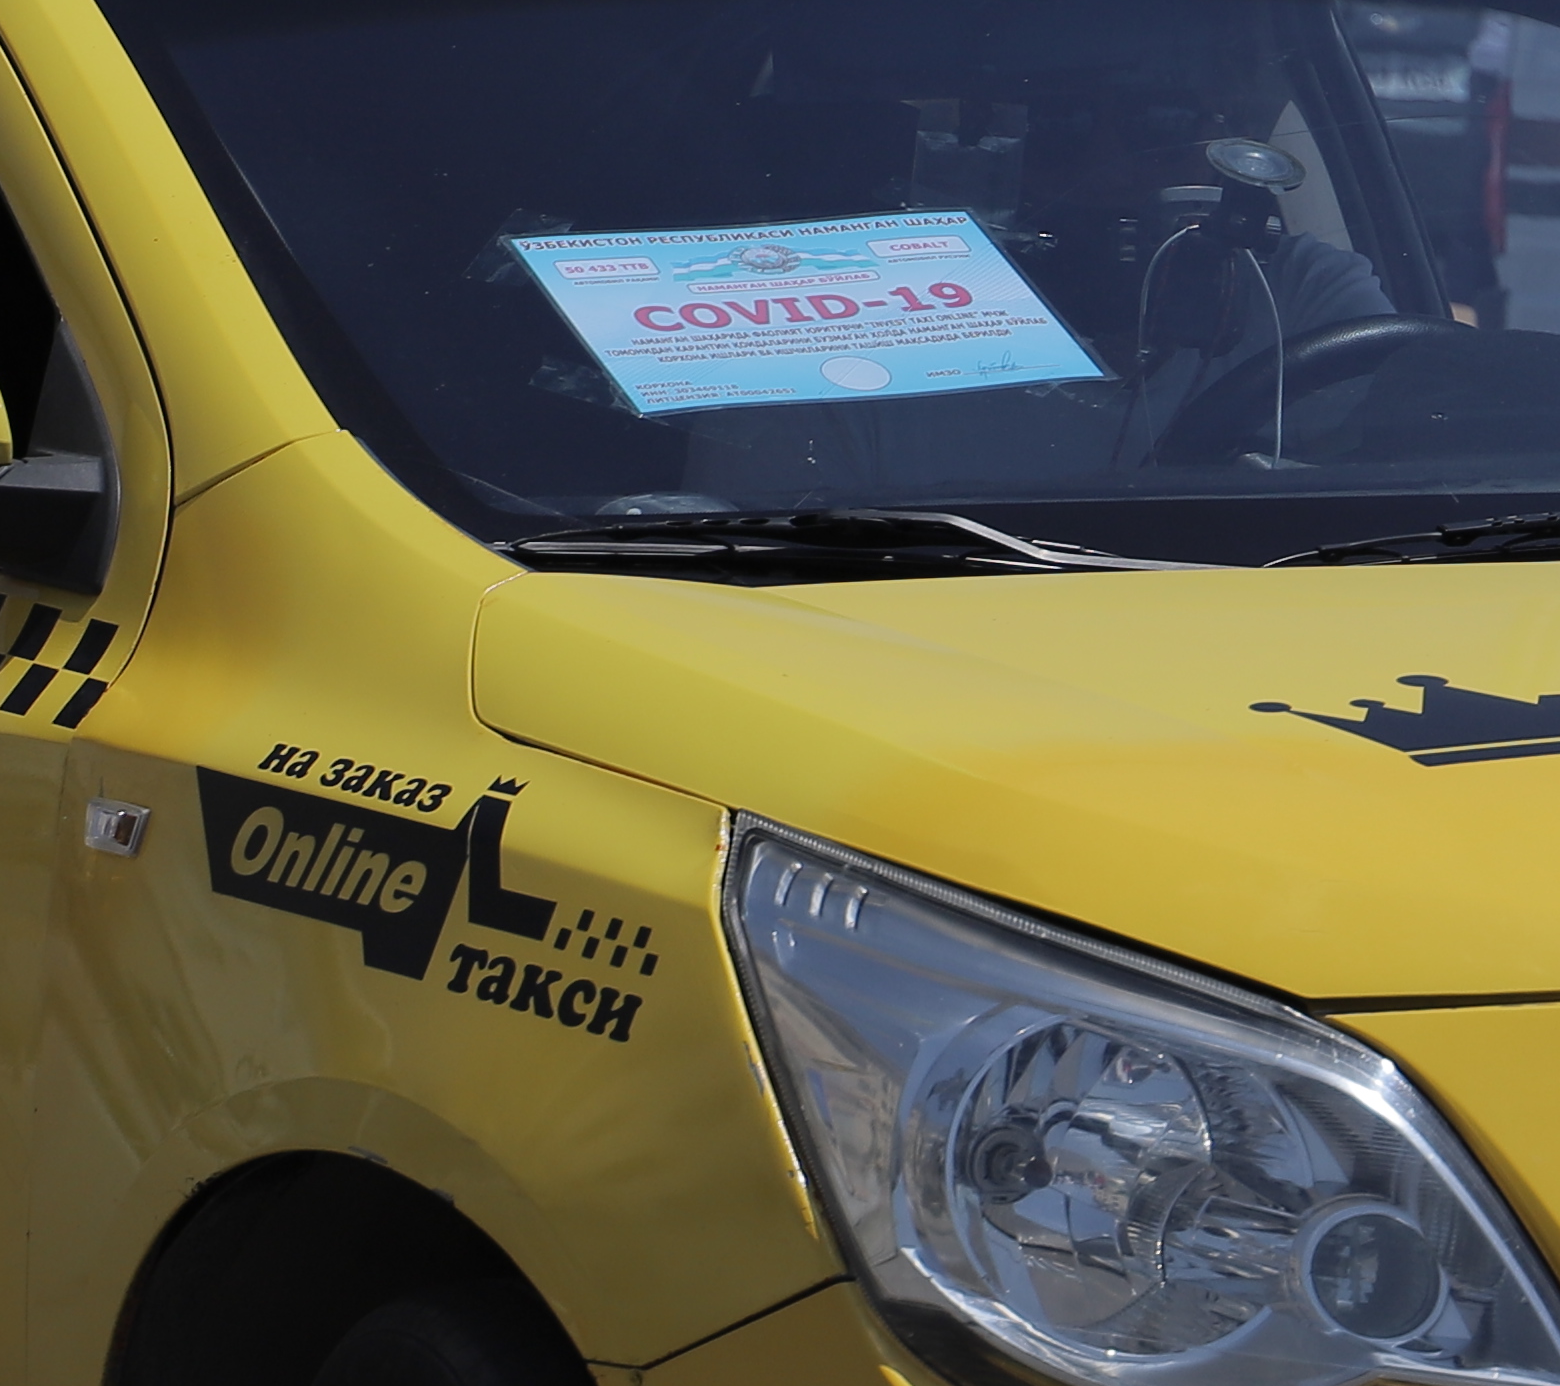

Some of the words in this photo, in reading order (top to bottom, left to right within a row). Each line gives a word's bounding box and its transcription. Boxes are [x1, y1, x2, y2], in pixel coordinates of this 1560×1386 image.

[647, 230, 794, 244] РЕСПУБЛИКАСИ
[798, 220, 899, 235] НАМАНГАН
[889, 242, 947, 251] COBALT
[589, 264, 617, 272] 433
[697, 283, 767, 291] НАМАНГАН
[634, 282, 973, 331] COVID-19
[908, 323, 965, 334] НАМАНГАН
[631, 336, 689, 345] НАМАНГАН
[320, 757, 452, 813] заказ
[230, 806, 427, 914] Online
[447, 943, 643, 1043] такси
